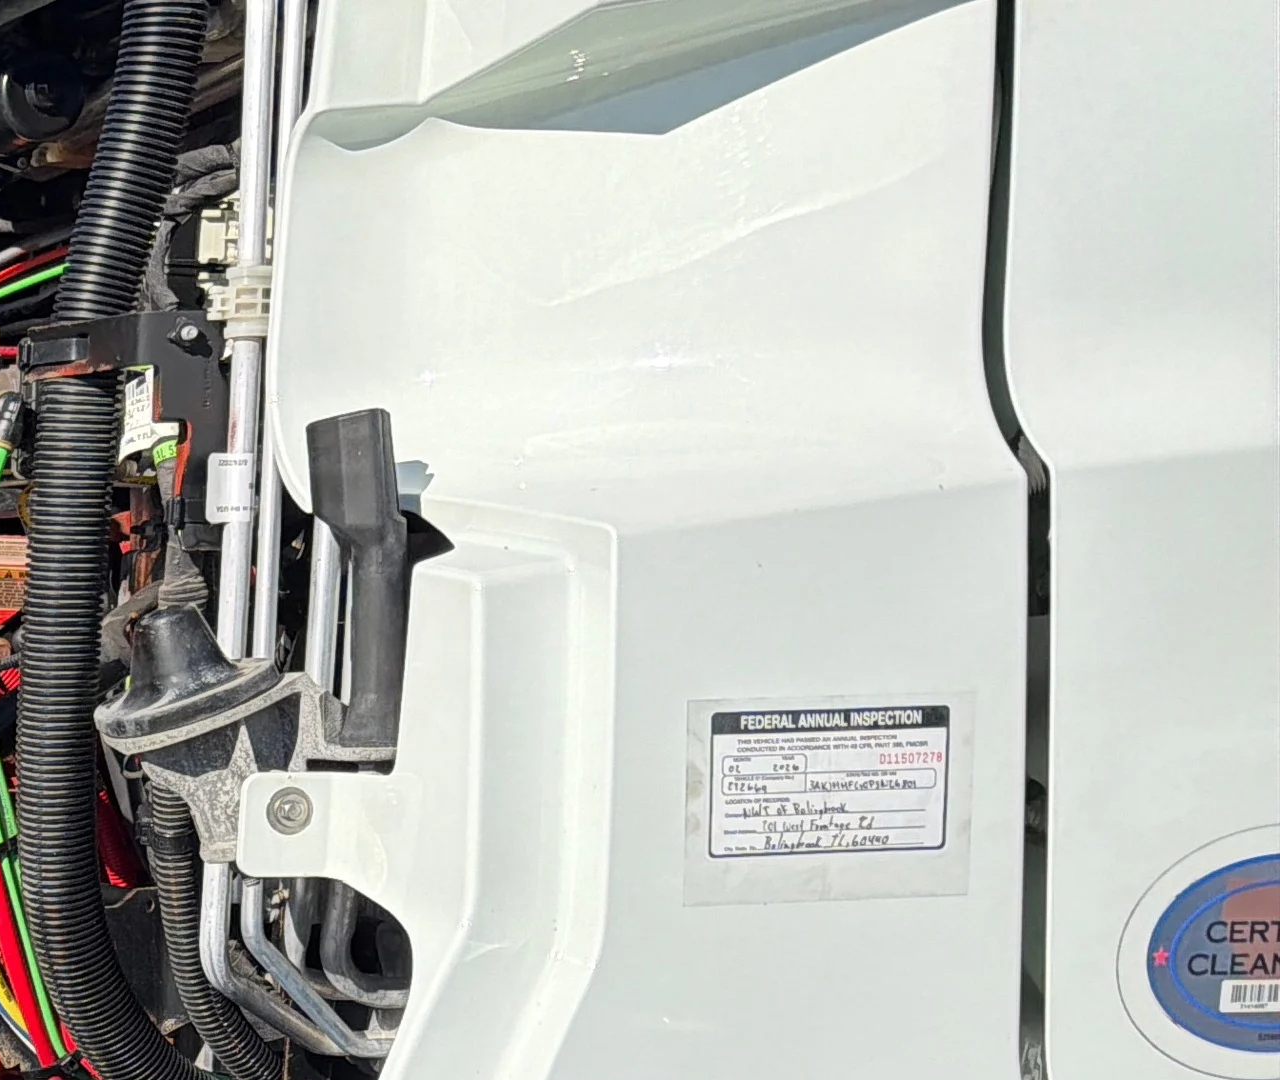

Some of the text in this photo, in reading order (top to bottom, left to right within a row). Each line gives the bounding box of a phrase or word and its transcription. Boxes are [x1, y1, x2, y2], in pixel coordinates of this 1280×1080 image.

[740, 709, 922, 730] FEDERAL ANNUAL INSPECTION
[879, 752, 942, 765] D11507278
